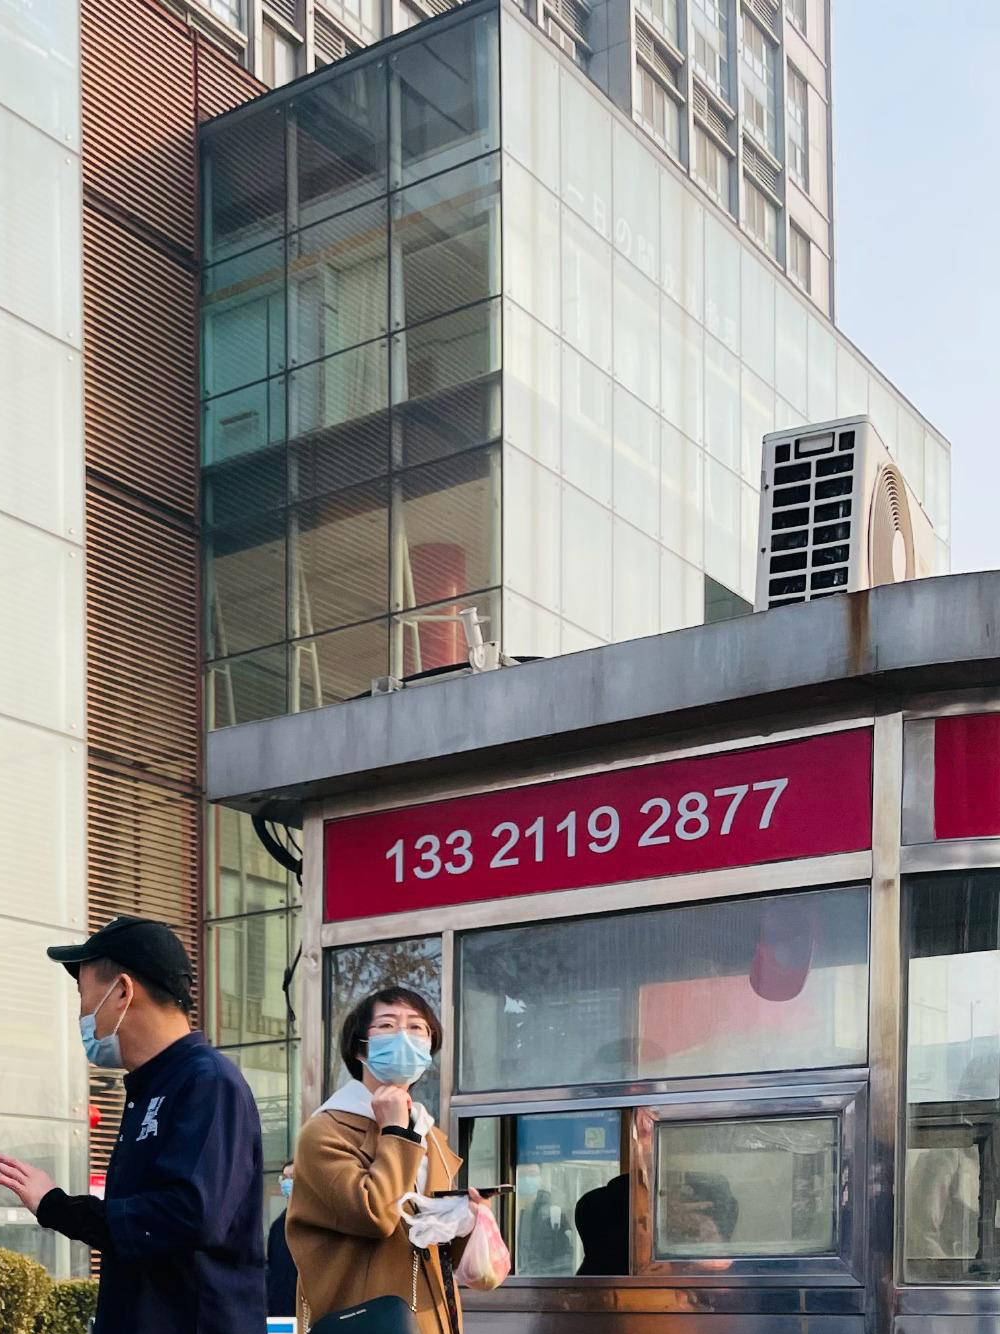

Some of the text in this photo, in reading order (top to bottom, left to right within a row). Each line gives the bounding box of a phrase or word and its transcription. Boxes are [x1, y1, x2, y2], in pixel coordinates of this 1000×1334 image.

[386, 777, 790, 883] 133 2119 2877
